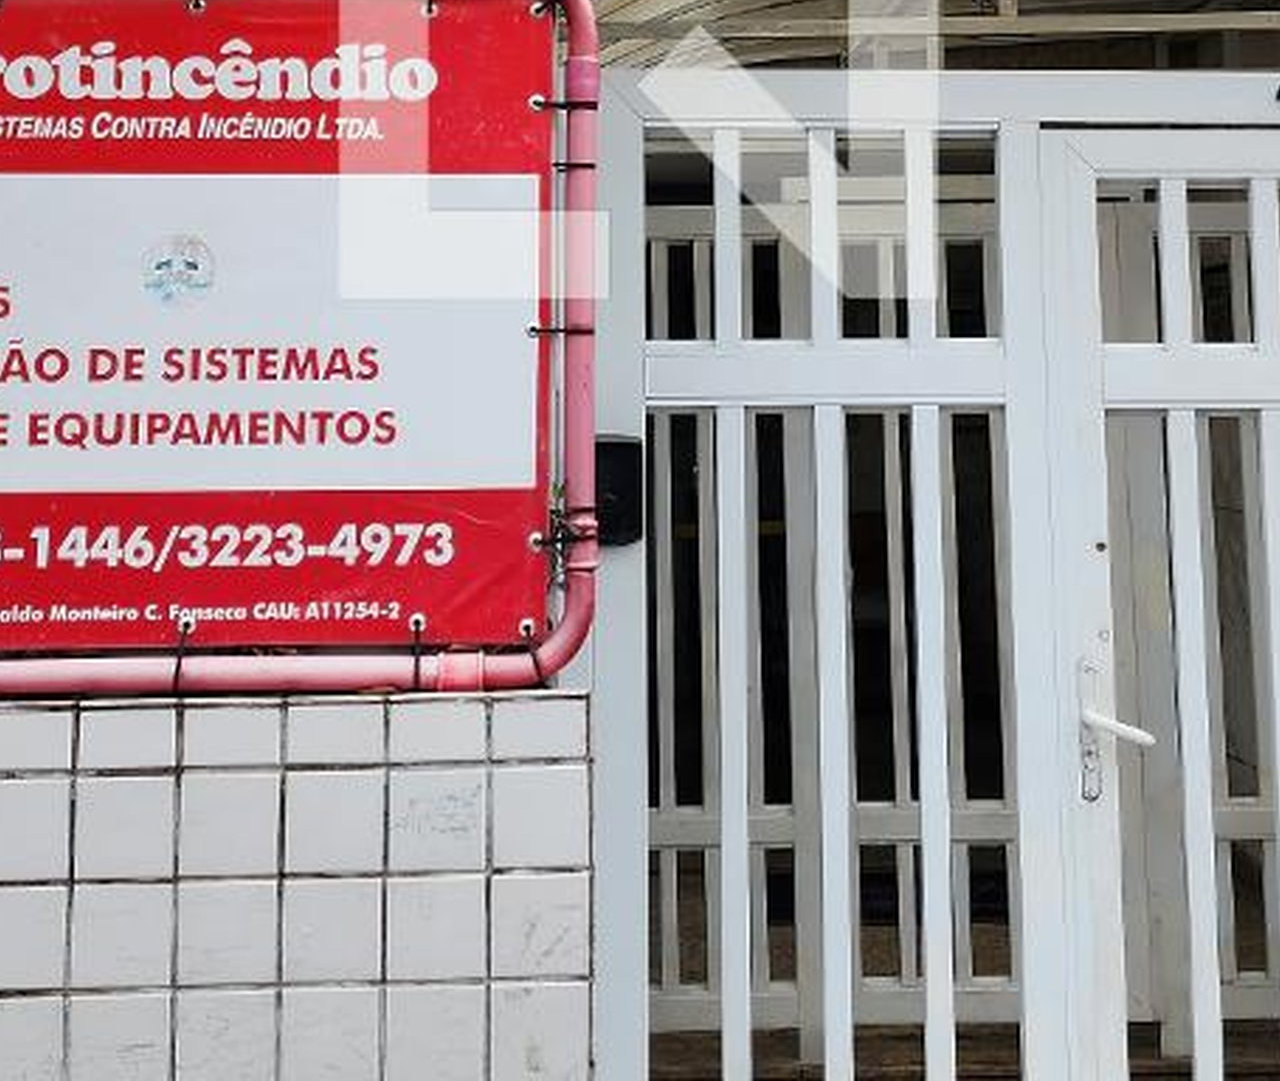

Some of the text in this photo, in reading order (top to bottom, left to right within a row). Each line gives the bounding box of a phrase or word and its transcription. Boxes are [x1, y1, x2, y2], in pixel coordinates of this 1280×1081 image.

[90, 111, 192, 140] CONTRA
[316, 112, 386, 141] LTDA.
[87, 347, 146, 382] DE
[160, 347, 381, 382] SISTEMAS
[27, 409, 398, 450] EQUIPAMENTOS
[49, 603, 139, 622] Monteiro
[144, 603, 163, 622] C.
[168, 603, 248, 622] Fonseca
[253, 601, 301, 620] CAU:
